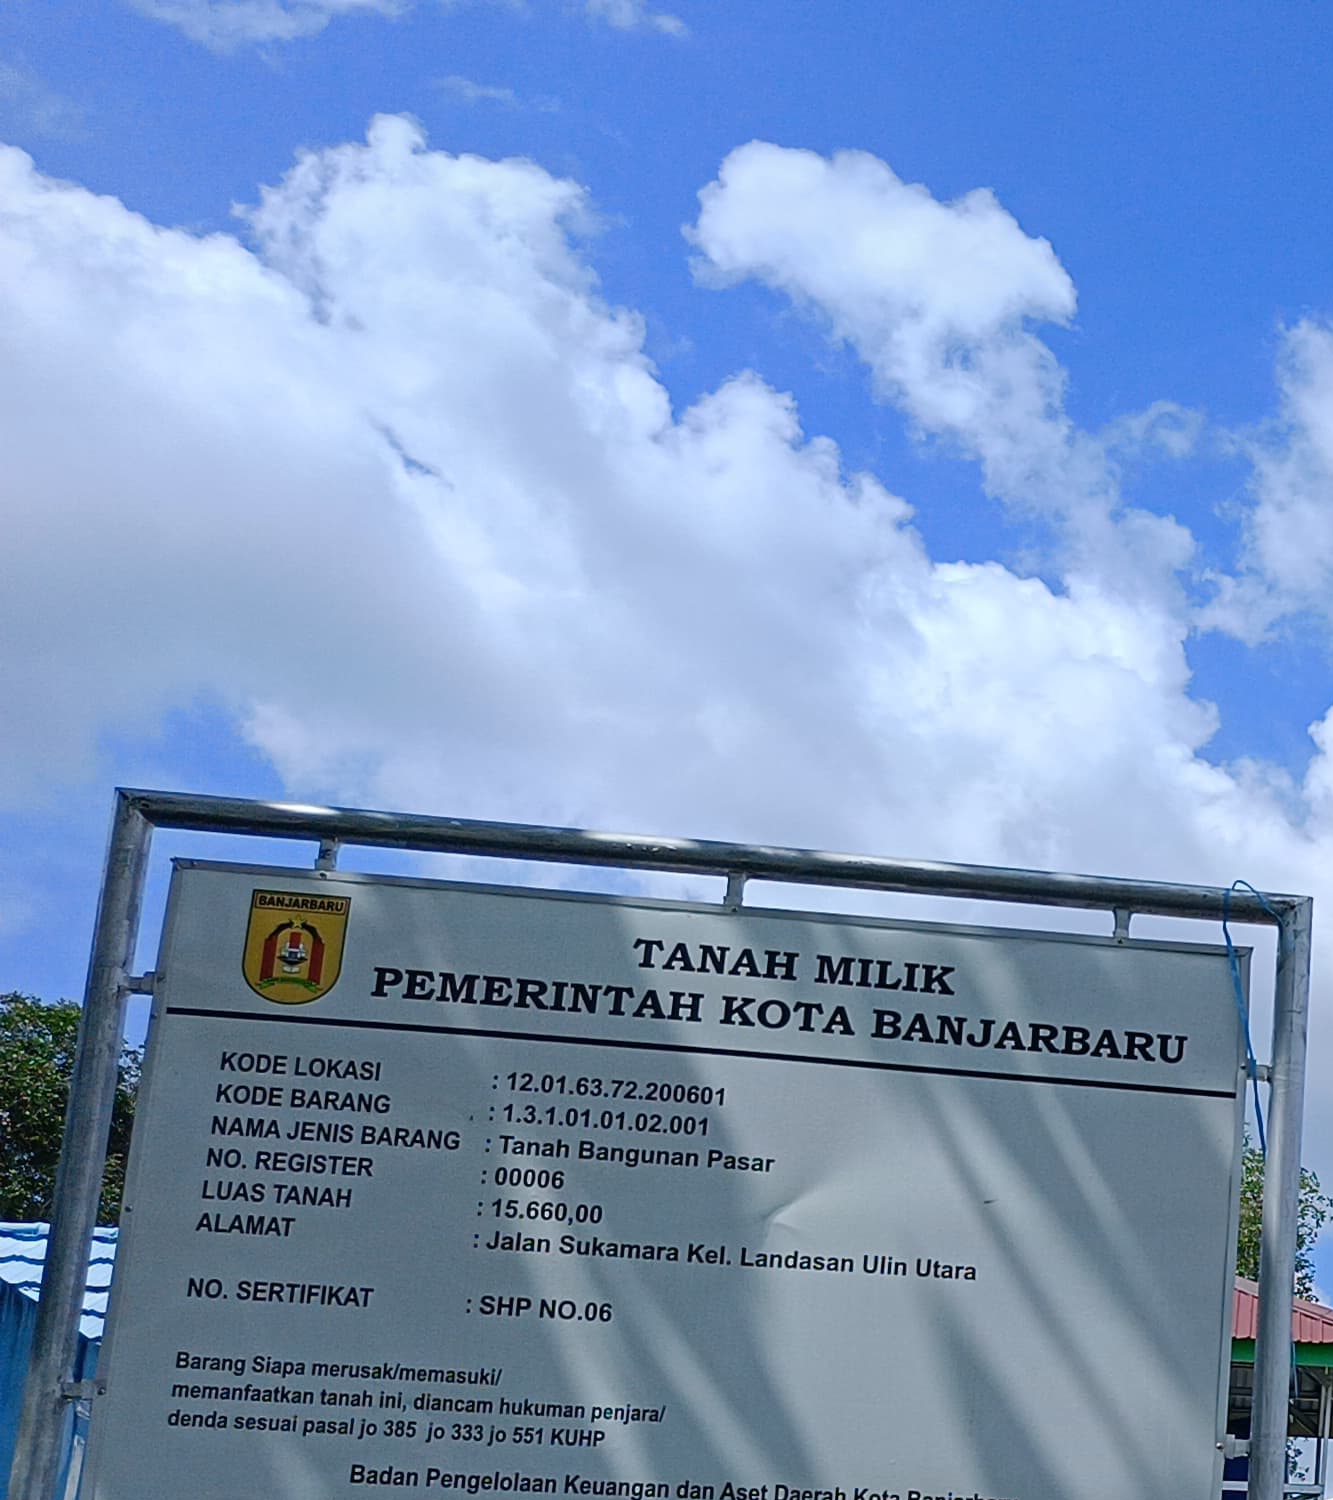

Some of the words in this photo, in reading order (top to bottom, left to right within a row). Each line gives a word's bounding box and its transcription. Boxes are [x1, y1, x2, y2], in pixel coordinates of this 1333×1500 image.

[258, 894, 344, 912] BANJARBARU
[633, 938, 799, 981] TANAH
[814, 955, 955, 995] MILIK
[371, 967, 704, 1022] PEMERINTAH
[720, 996, 855, 1035] KOTA
[871, 1009, 1188, 1063] BANJARBARU
[220, 1052, 287, 1074] KODE
[294, 1057, 381, 1081] LOKASI
[507, 1072, 726, 1106] 12.01.63.72.200601
[216, 1084, 283, 1106] KODE
[290, 1089, 390, 1113] BARANG
[503, 1104, 709, 1136] 1.3.1.01.01.02.001
[212, 1116, 280, 1138] NAMA
[287, 1121, 353, 1143] JENIS
[361, 1126, 460, 1150] BARANG
[499, 1135, 569, 1158] Tanah
[579, 1141, 698, 1167] Bangunan
[708, 1150, 775, 1172] Pasar
[207, 1148, 246, 1169] NO.
[255, 1151, 373, 1176] REGISTER
[495, 1167, 564, 1189] 00006
[202, 1180, 265, 1202] LUAS
[274, 1184, 352, 1207] TANAH
[492, 1199, 602, 1225] 15.660,00
[196, 1213, 296, 1236] ALAMAT
[486, 1231, 550, 1253] Jalan
[559, 1235, 678, 1261] Sukamara
[687, 1244, 731, 1265] Kel.
[741, 1247, 853, 1272] Landasan
[863, 1255, 907, 1276] Ulin
[916, 1258, 976, 1280] Utara
[187, 1278, 227, 1299] NO.
[236, 1281, 374, 1307] SERTIFIKAT
[480, 1296, 531, 1316] SHP
[540, 1299, 612, 1322] NO.06
[176, 1352, 246, 1376] Barang
[252, 1356, 305, 1378] Siapa
[312, 1363, 502, 1385] merusak/memasuki/
[172, 1384, 314, 1404] memanfaatkan
[320, 1389, 372, 1407] tanah
[380, 1391, 406, 1412] ini,
[414, 1393, 492, 1413] diancam
[500, 1398, 585, 1418] hukuman
[591, 1404, 666, 1425] penjara/
[168, 1409, 227, 1428] denda
[234, 1415, 297, 1432] sesuai
[303, 1418, 355, 1439] pasal
[357, 1419, 377, 1438] jo
[384, 1420, 417, 1438] 385
[425, 1422, 445, 1443] jo
[451, 1424, 485, 1442] 333
[488, 1427, 506, 1446] jo
[513, 1427, 543, 1444] 551
[551, 1428, 605, 1447] KUHP
[350, 1464, 418, 1486] Badan
[426, 1468, 556, 1494] Pengelolaan
[564, 1475, 669, 1500] Keuangan
[677, 1480, 714, 1500] dan
